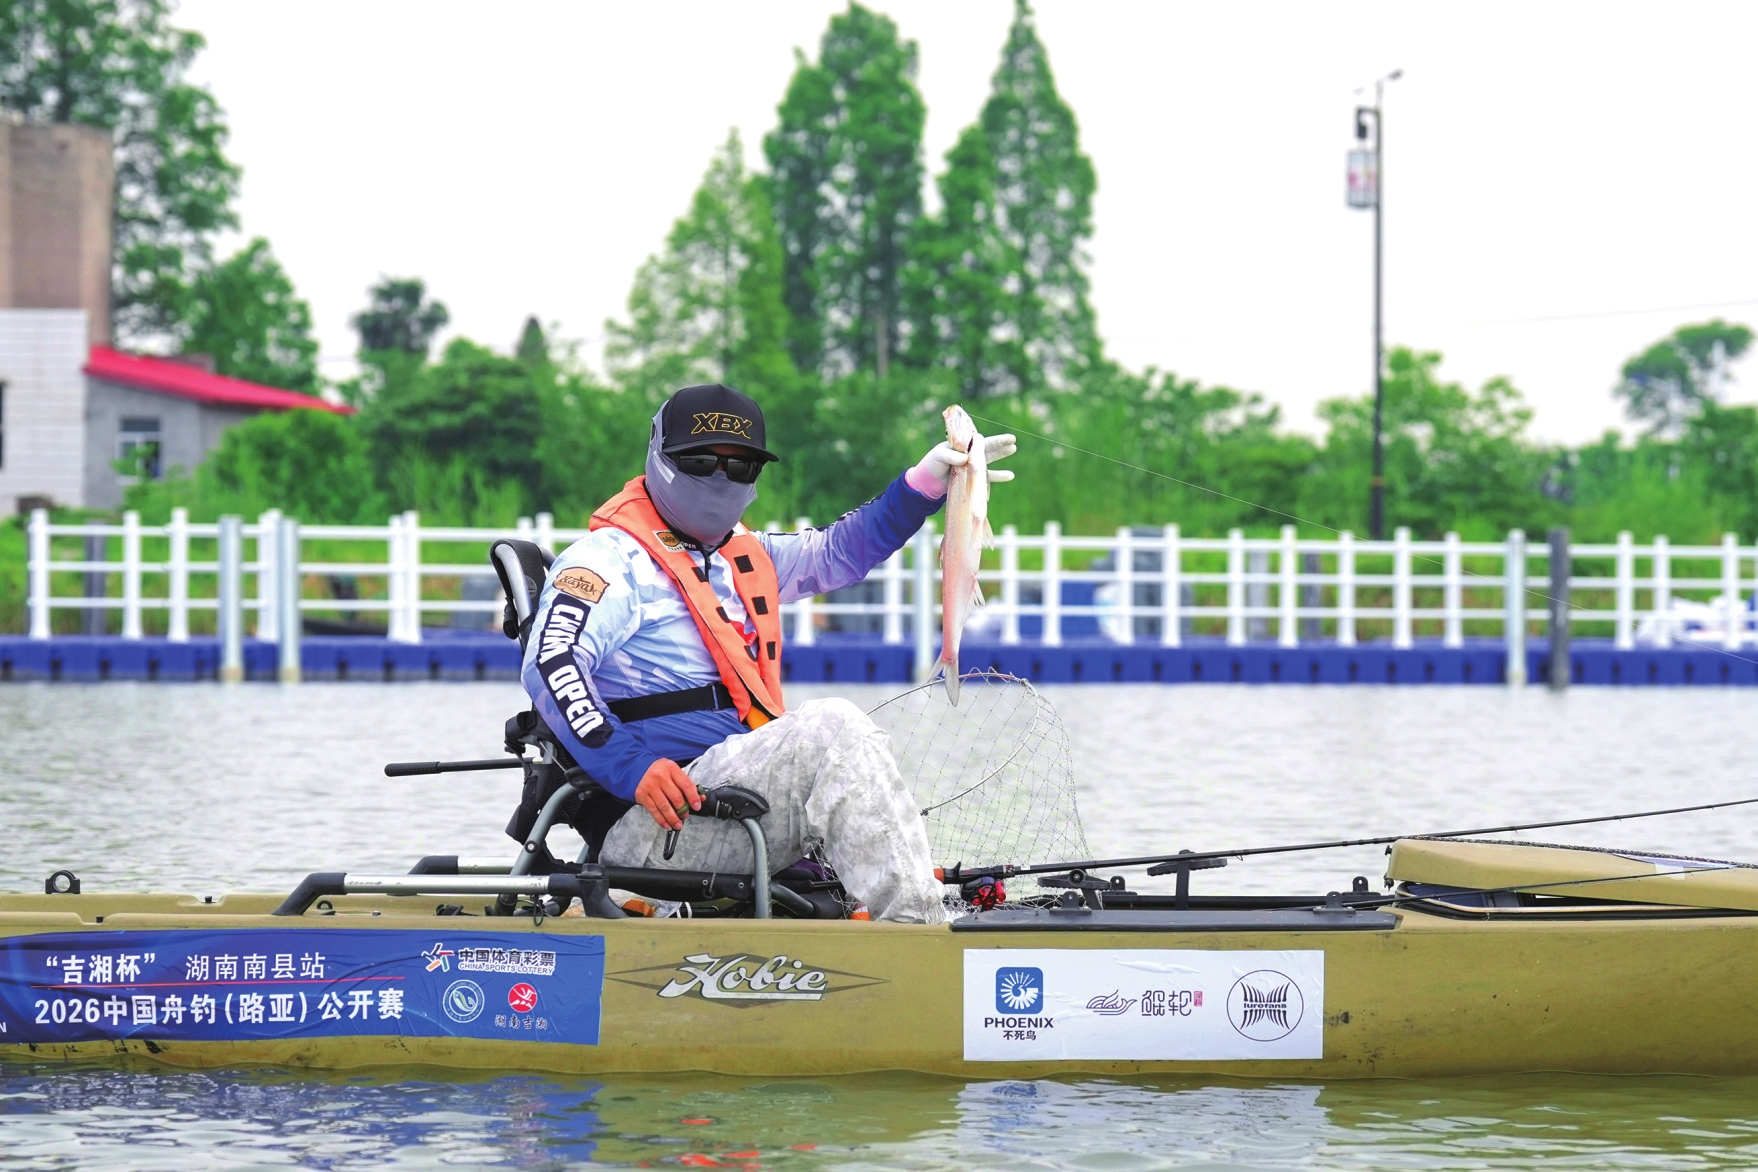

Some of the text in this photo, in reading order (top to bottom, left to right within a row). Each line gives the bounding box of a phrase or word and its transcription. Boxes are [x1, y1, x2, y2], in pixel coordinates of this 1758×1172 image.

[691, 412, 752, 439] XBX
[539, 604, 604, 739] CHINA OPEN
[185, 952, 325, 981] 湖南南县站
[459, 948, 555, 967] 中国体育彩票
[483, 964, 516, 972] SPORTS
[517, 966, 554, 975] LOTTERY
[657, 953, 828, 1000] Hobie
[984, 1017, 1054, 1029] PHOENIX
[1002, 1030, 1037, 1041] 不死鸟
